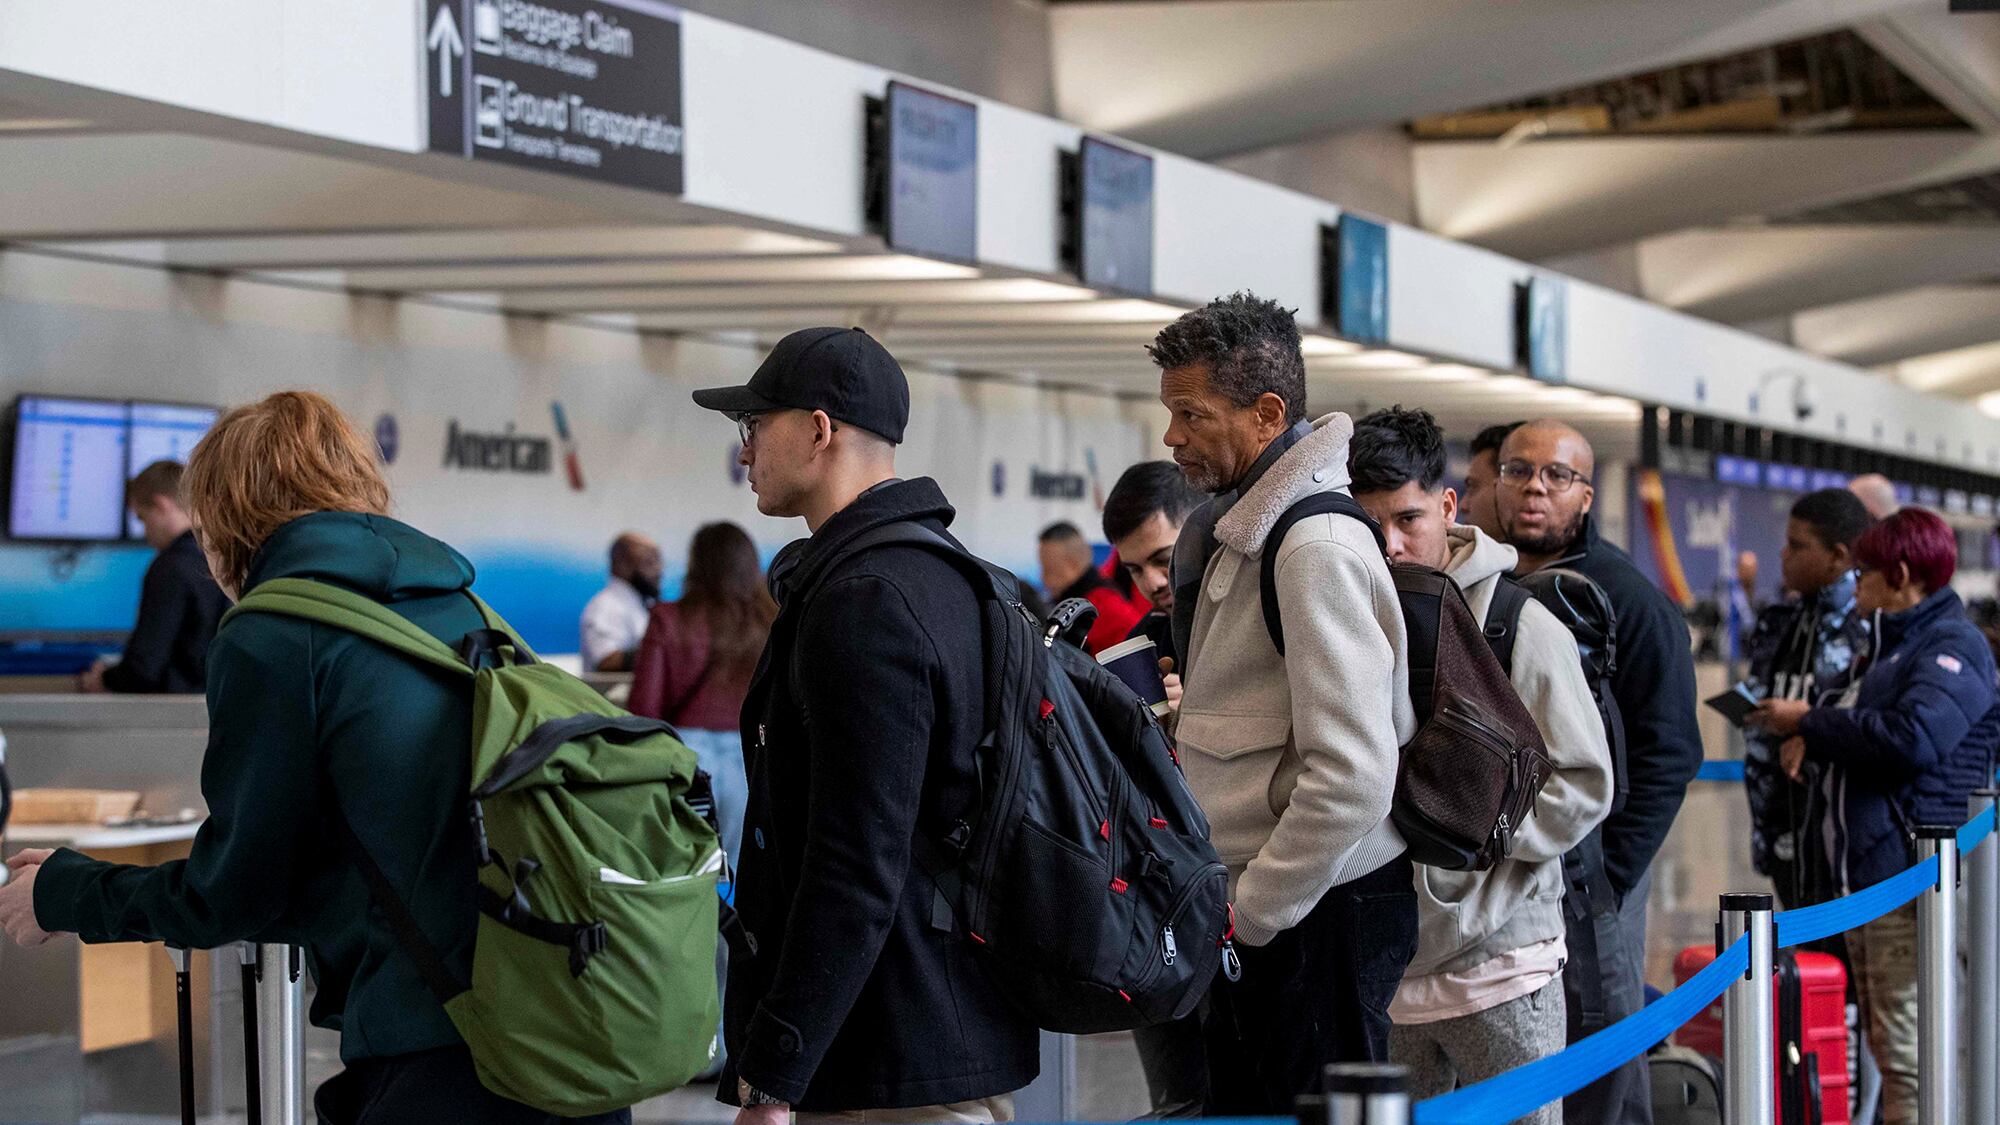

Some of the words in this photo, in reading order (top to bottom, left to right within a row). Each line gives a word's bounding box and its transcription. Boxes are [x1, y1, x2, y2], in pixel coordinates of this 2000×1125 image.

[583, 10, 635, 58] Claim
[503, 80, 569, 132] Ground
[443, 418, 551, 473] American
